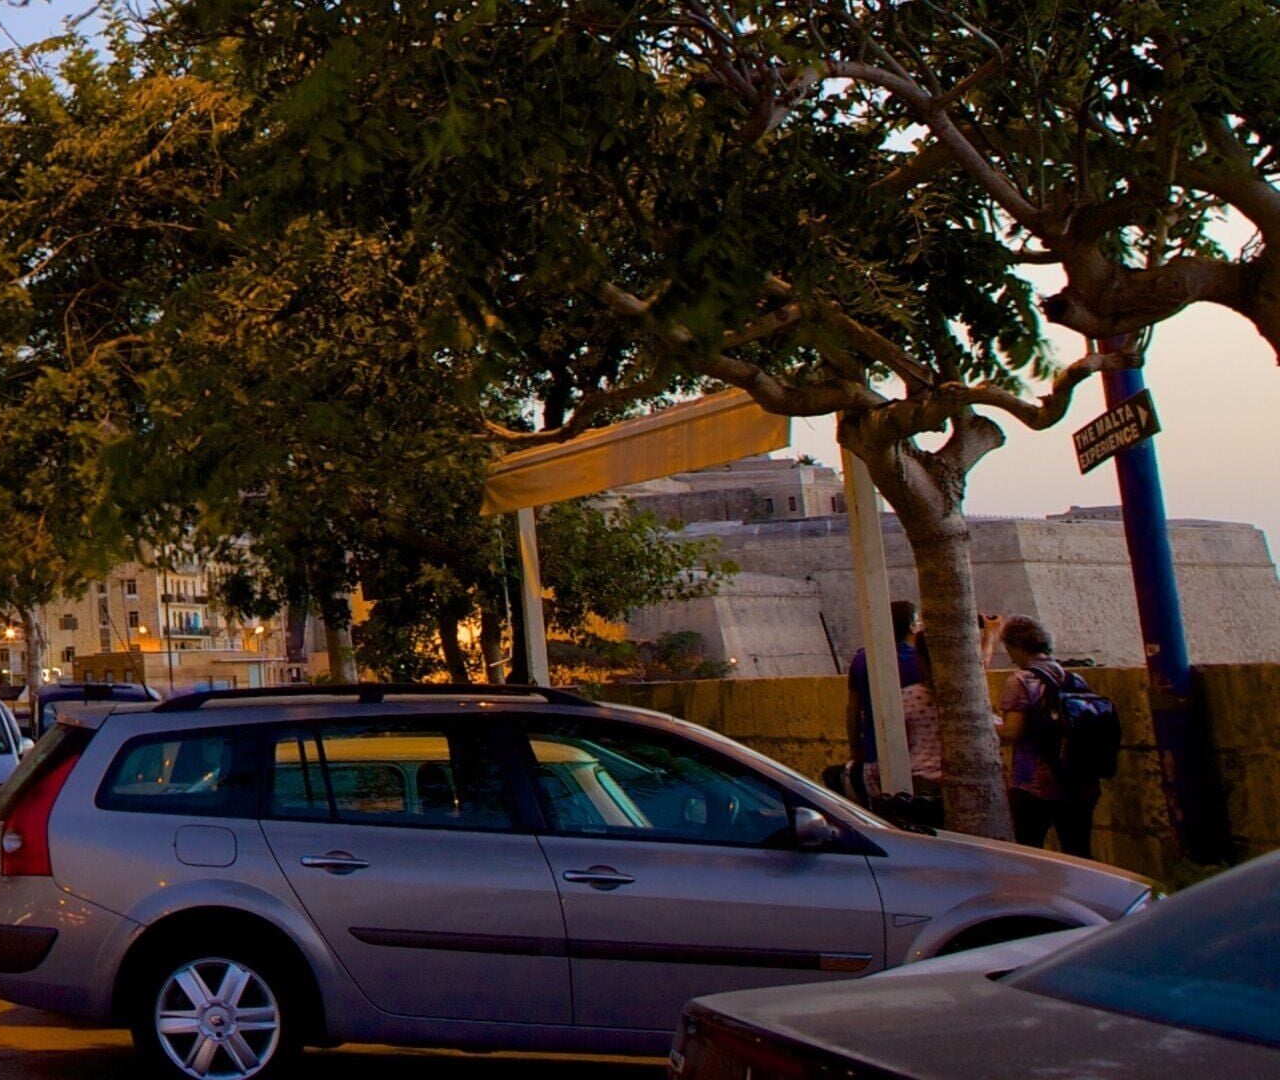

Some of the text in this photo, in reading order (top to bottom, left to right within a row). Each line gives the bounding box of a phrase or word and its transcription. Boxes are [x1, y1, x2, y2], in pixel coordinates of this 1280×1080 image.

[1074, 403, 1135, 450] THE MALTA
[1079, 422, 1140, 469] EXPERIENCE
